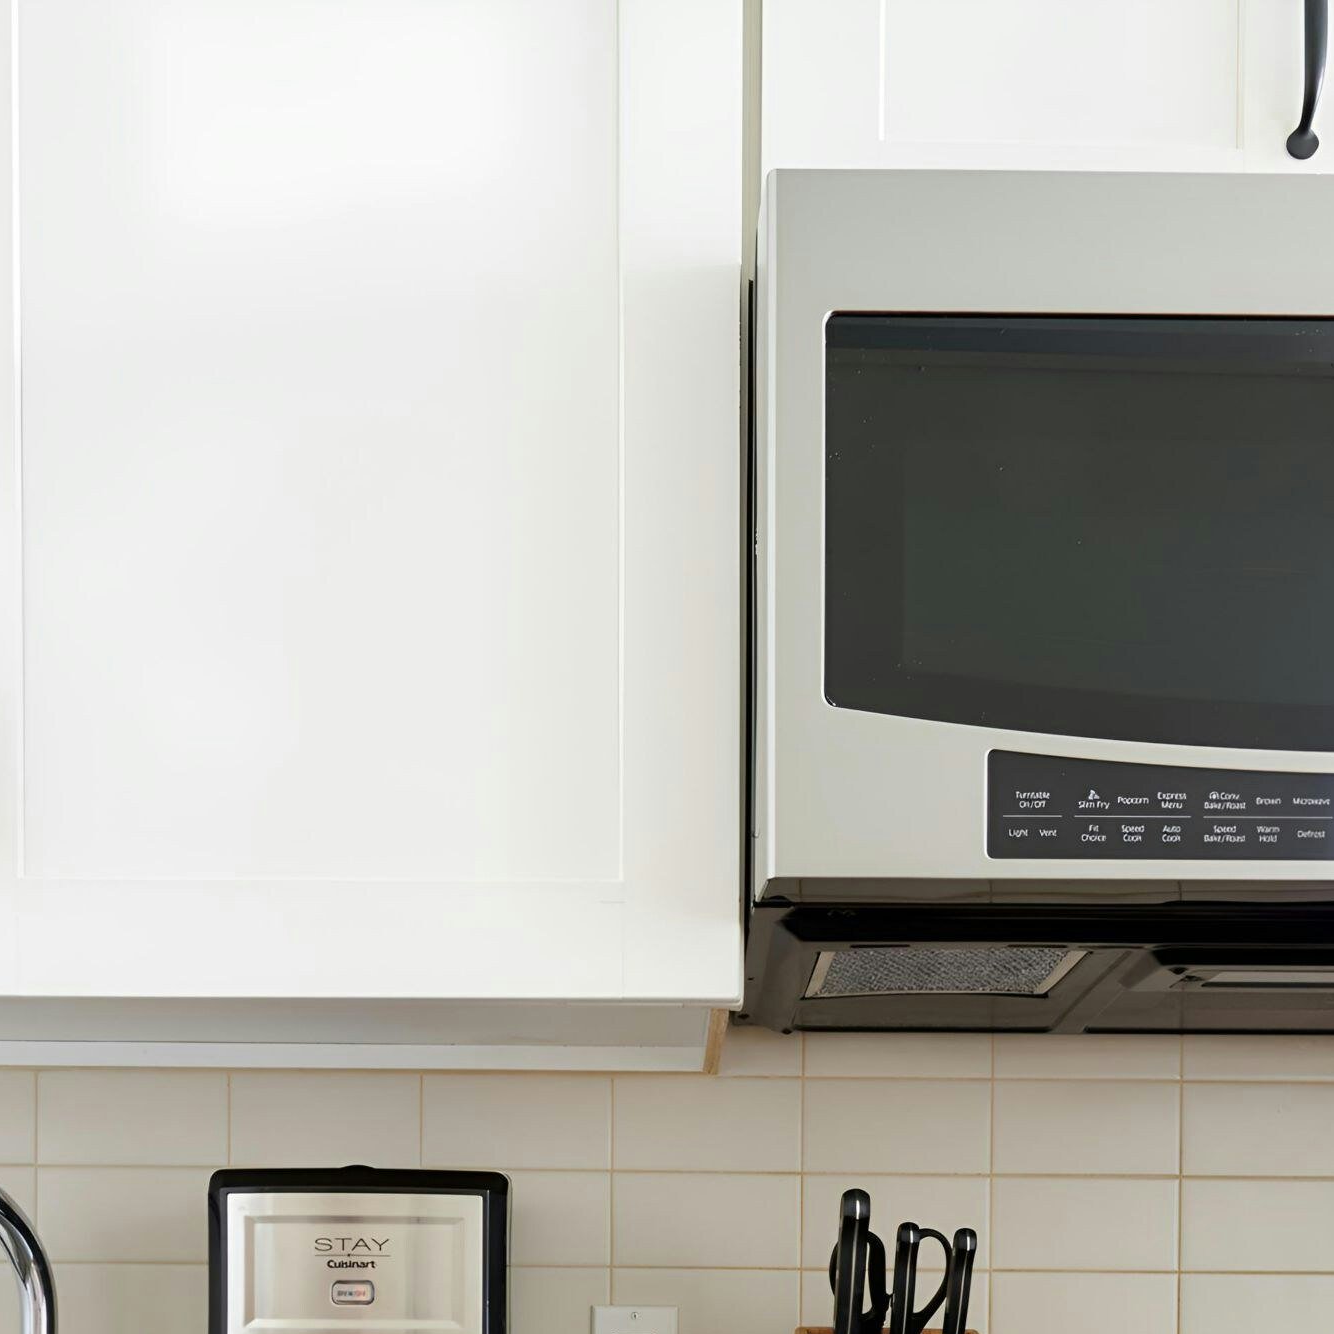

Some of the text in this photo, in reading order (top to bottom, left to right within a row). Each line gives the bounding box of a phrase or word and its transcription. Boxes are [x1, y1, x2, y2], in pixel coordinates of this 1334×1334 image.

[1117, 796, 1150, 806] Popcorn
[1157, 791, 1187, 802] Express
[1160, 801, 1183, 810] Menu
[1008, 829, 1029, 838] Light
[1039, 829, 1058, 838] Vent
[1121, 825, 1146, 835] Speed
[1162, 825, 1181, 834] Auto
[1081, 833, 1107, 842] Choice
[1297, 830, 1326, 839] Defrost
[314, 1237, 390, 1253] STAY
[326, 1259, 376, 1269] Cuisinart
